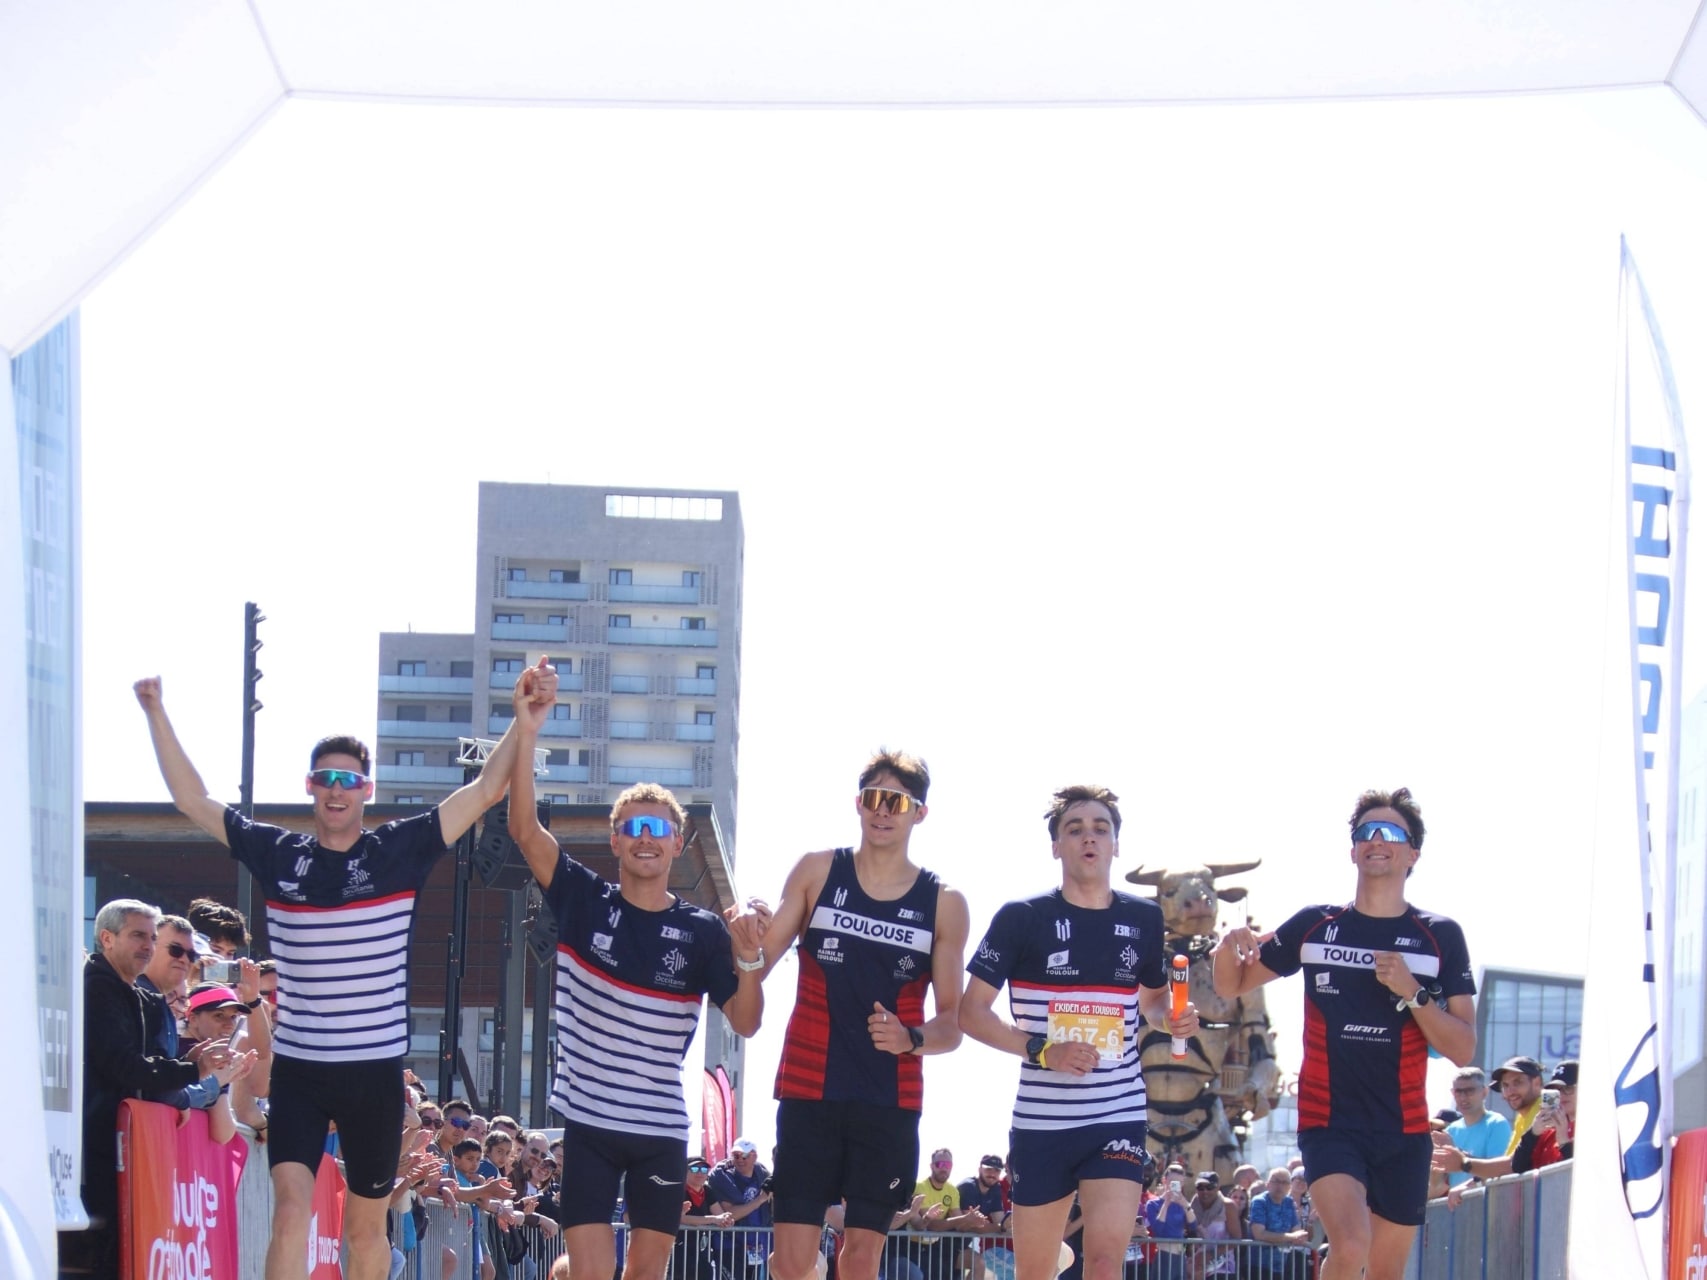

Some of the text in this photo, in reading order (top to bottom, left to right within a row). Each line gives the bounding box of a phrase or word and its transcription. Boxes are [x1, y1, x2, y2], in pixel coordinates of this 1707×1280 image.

[833, 913, 915, 944] TOULOUSE
[817, 954, 844, 963] TOULOUSE
[1054, 1002, 1080, 1014] EKIDEN
[1343, 1024, 1388, 1035] GIANT
[1052, 1026, 1120, 1047] 467-6
